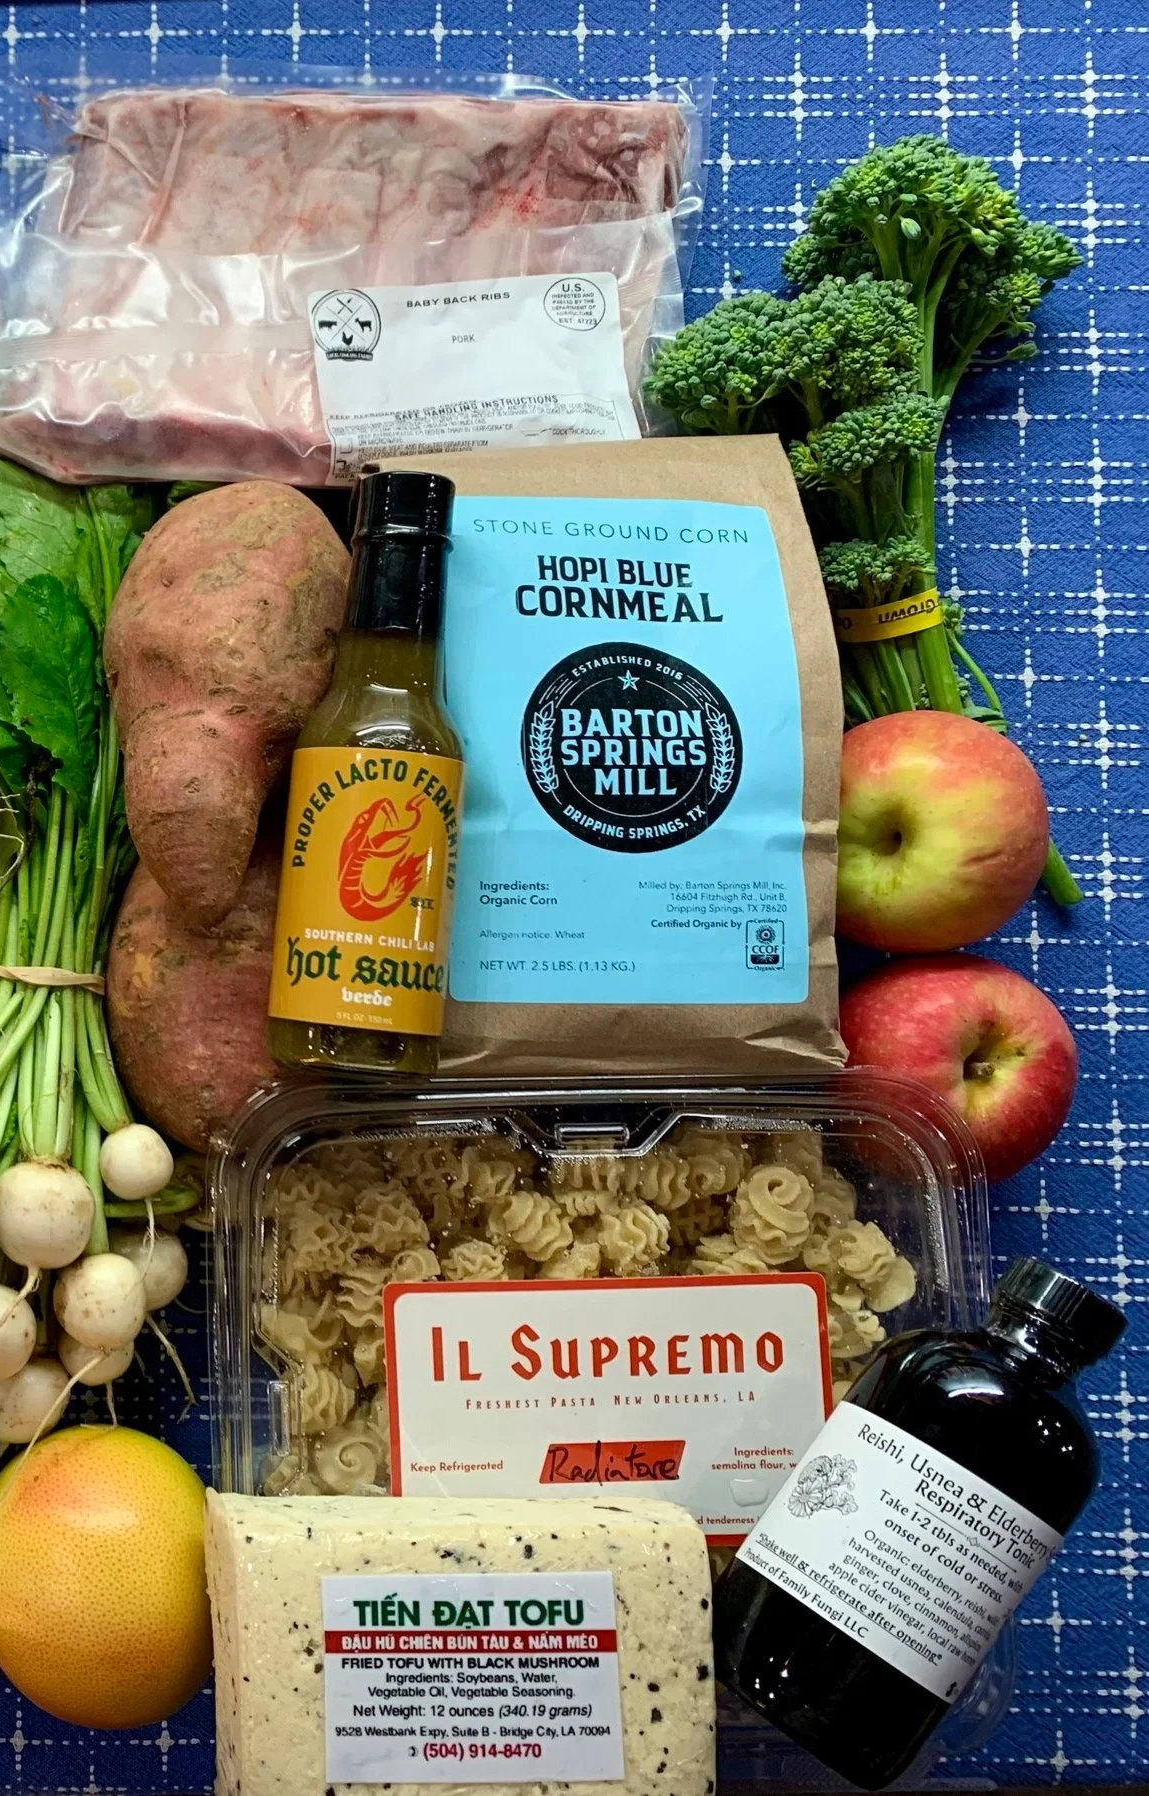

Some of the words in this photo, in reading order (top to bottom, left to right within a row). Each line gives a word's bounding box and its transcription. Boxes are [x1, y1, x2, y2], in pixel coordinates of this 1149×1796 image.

[562, 283, 585, 292] U.S.
[406, 298, 439, 308] BABY
[444, 295, 477, 306] BACK
[481, 292, 511, 302] RIBS
[452, 334, 476, 344] PORK
[423, 403, 479, 416] HANDLING
[481, 394, 559, 409] INSTRUCTIONS
[473, 518, 553, 536] STONE
[564, 522, 669, 541] GROUND
[679, 528, 749, 544] CORN
[537, 555, 607, 583] HOPI
[617, 559, 693, 588] BLUE
[516, 584, 723, 623] CORNMEAL
[878, 598, 935, 624] Grown
[572, 655, 652, 678] ESTABLISHED
[655, 662, 683, 681] 2016
[560, 708, 704, 738] BARTON
[561, 738, 707, 766] SPRINGS
[594, 768, 678, 796] MILL
[292, 781, 336, 868] PROPER
[335, 758, 408, 789] LACTO
[413, 767, 459, 890] FERMENTED
[563, 804, 624, 839] DRIPPING
[628, 816, 689, 840] SPRINGS,
[686, 806, 706, 822] TX
[479, 880, 550, 893] Ingredients:
[479, 894, 527, 908] Organic
[529, 894, 558, 905] Corn
[666, 904, 707, 915] Dripping
[708, 904, 745, 915] Springs,
[747, 904, 759, 913] TX
[760, 904, 788, 913] 78620
[554, 930, 585, 939] Wheat
[650, 919, 691, 929] Certified
[692, 919, 729, 930] Organic
[730, 919, 742, 931] by
[304, 928, 373, 945] SOUTHERN
[378, 935, 412, 950] CHILI
[416, 941, 435, 953] LAB
[752, 945, 780, 954] CCOF
[287, 936, 342, 987] hot
[351, 955, 445, 993] sauce
[480, 960, 504, 971] NET
[531, 960, 549, 971] 2.5
[552, 960, 577, 971] LBS.
[578, 960, 608, 973] (1.13
[611, 960, 636, 973] KG.)
[341, 986, 393, 1007] verde
[737, 1391, 756, 1402] LA
[734, 1446, 794, 1458] Ingredients:
[410, 1461, 437, 1474] Keep
[439, 1460, 504, 1474] Refrigerated
[711, 1460, 756, 1470] semolina
[760, 1459, 785, 1470] flour,
[857, 1424, 905, 1464] Reishi,
[910, 1453, 964, 1498] Usnea
[966, 1493, 988, 1513] &
[707, 1516, 754, 1524] tenderness
[915, 1479, 1005, 1549] Respiratory
[1005, 1540, 1036, 1569] Tonic
[879, 1489, 909, 1516] Take
[910, 1511, 932, 1530] 1-2
[931, 1525, 955, 1547] tbls
[956, 1544, 969, 1556] as
[969, 1552, 1006, 1586] needed,
[884, 1518, 924, 1547] onset
[922, 1542, 940, 1558] of
[937, 1553, 964, 1576] cold
[964, 1571, 979, 1584] or
[977, 1581, 1003, 1604] stress
[353, 1592, 420, 1627] TIẾN
[432, 1600, 494, 1629] ĐẠT
[504, 1599, 584, 1626] TOFU
[778, 1571, 811, 1600] Family
[811, 1594, 844, 1622] Fungi
[843, 1616, 869, 1639] LLC
[809, 1568, 867, 1613] refrigerate
[867, 1610, 896, 1633] after
[341, 1658, 383, 1669] FRIED
[387, 1658, 424, 1669] TOFU
[427, 1658, 463, 1669] WITH
[467, 1657, 514, 1669] BLACK
[518, 1657, 599, 1669] MUSHROOM
[386, 1672, 453, 1686] Ingredients:
[457, 1672, 518, 1685] Soybeans,
[521, 1672, 557, 1685] Water,
[368, 1687, 425, 1700] Vegetable
[429, 1686, 448, 1698] Oil,
[451, 1686, 508, 1700] Vegetable
[512, 1686, 575, 1700] Seasoning.
[353, 1705, 376, 1716] Net
[379, 1705, 425, 1720] Weight:
[431, 1705, 445, 1716] 12
[449, 1706, 494, 1717] ounces
[499, 1704, 546, 1719] (340.19
[549, 1704, 592, 1720] grams)
[335, 1726, 362, 1737] 9528
[364, 1726, 417, 1737] Westbank
[451, 1726, 479, 1737] Suite
[482, 1726, 490, 1737] B
[500, 1726, 534, 1740] Bridge
[536, 1726, 559, 1740] City,
[561, 1726, 576, 1736] LA
[579, 1726, 611, 1736] 70094
[423, 1743, 464, 1762] (504)
[469, 1743, 542, 1758] 914-8470
